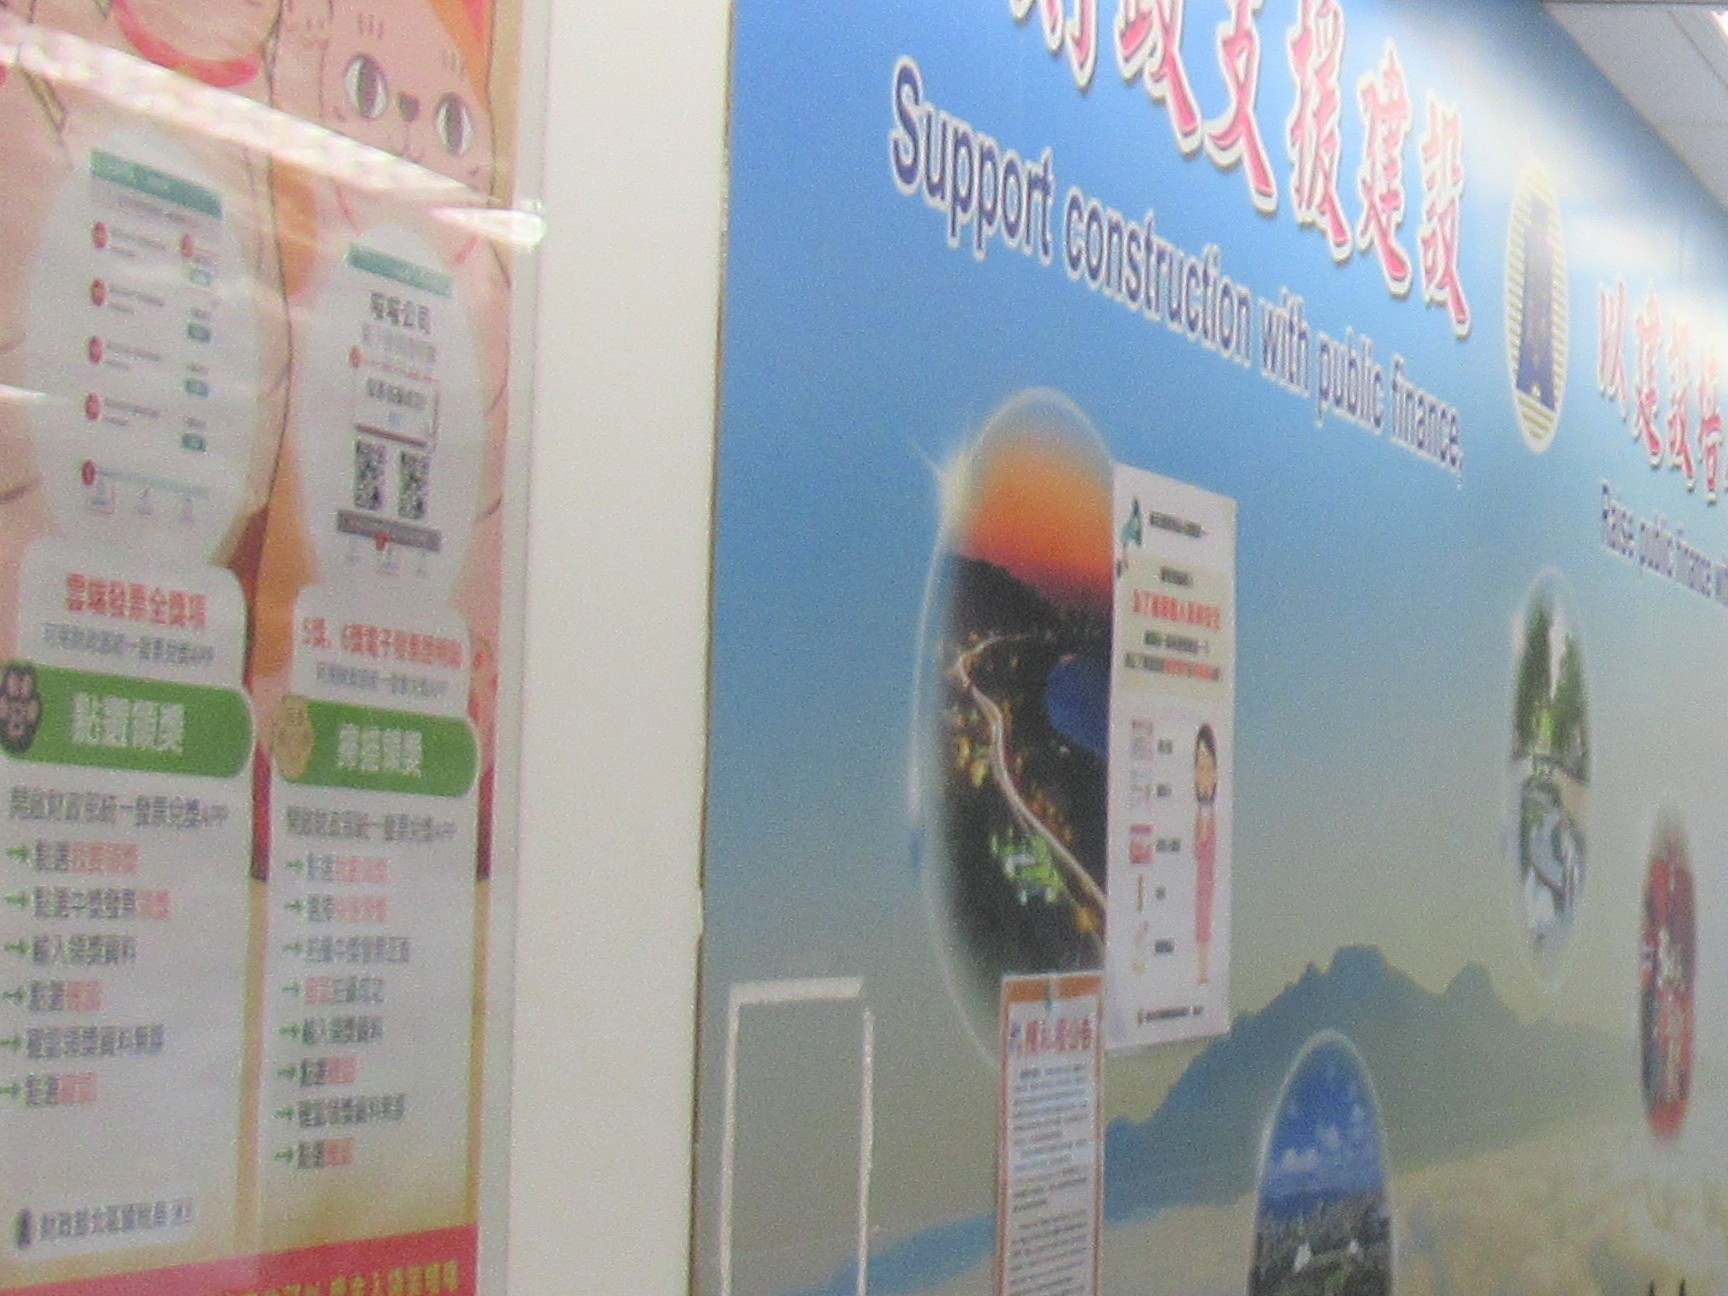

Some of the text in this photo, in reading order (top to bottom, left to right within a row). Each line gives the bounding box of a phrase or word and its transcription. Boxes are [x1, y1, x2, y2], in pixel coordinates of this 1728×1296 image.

[892, 58, 1054, 264] Support
[1063, 186, 1253, 368] construction
[1259, 286, 1311, 399] with
[1316, 322, 1385, 428] public
